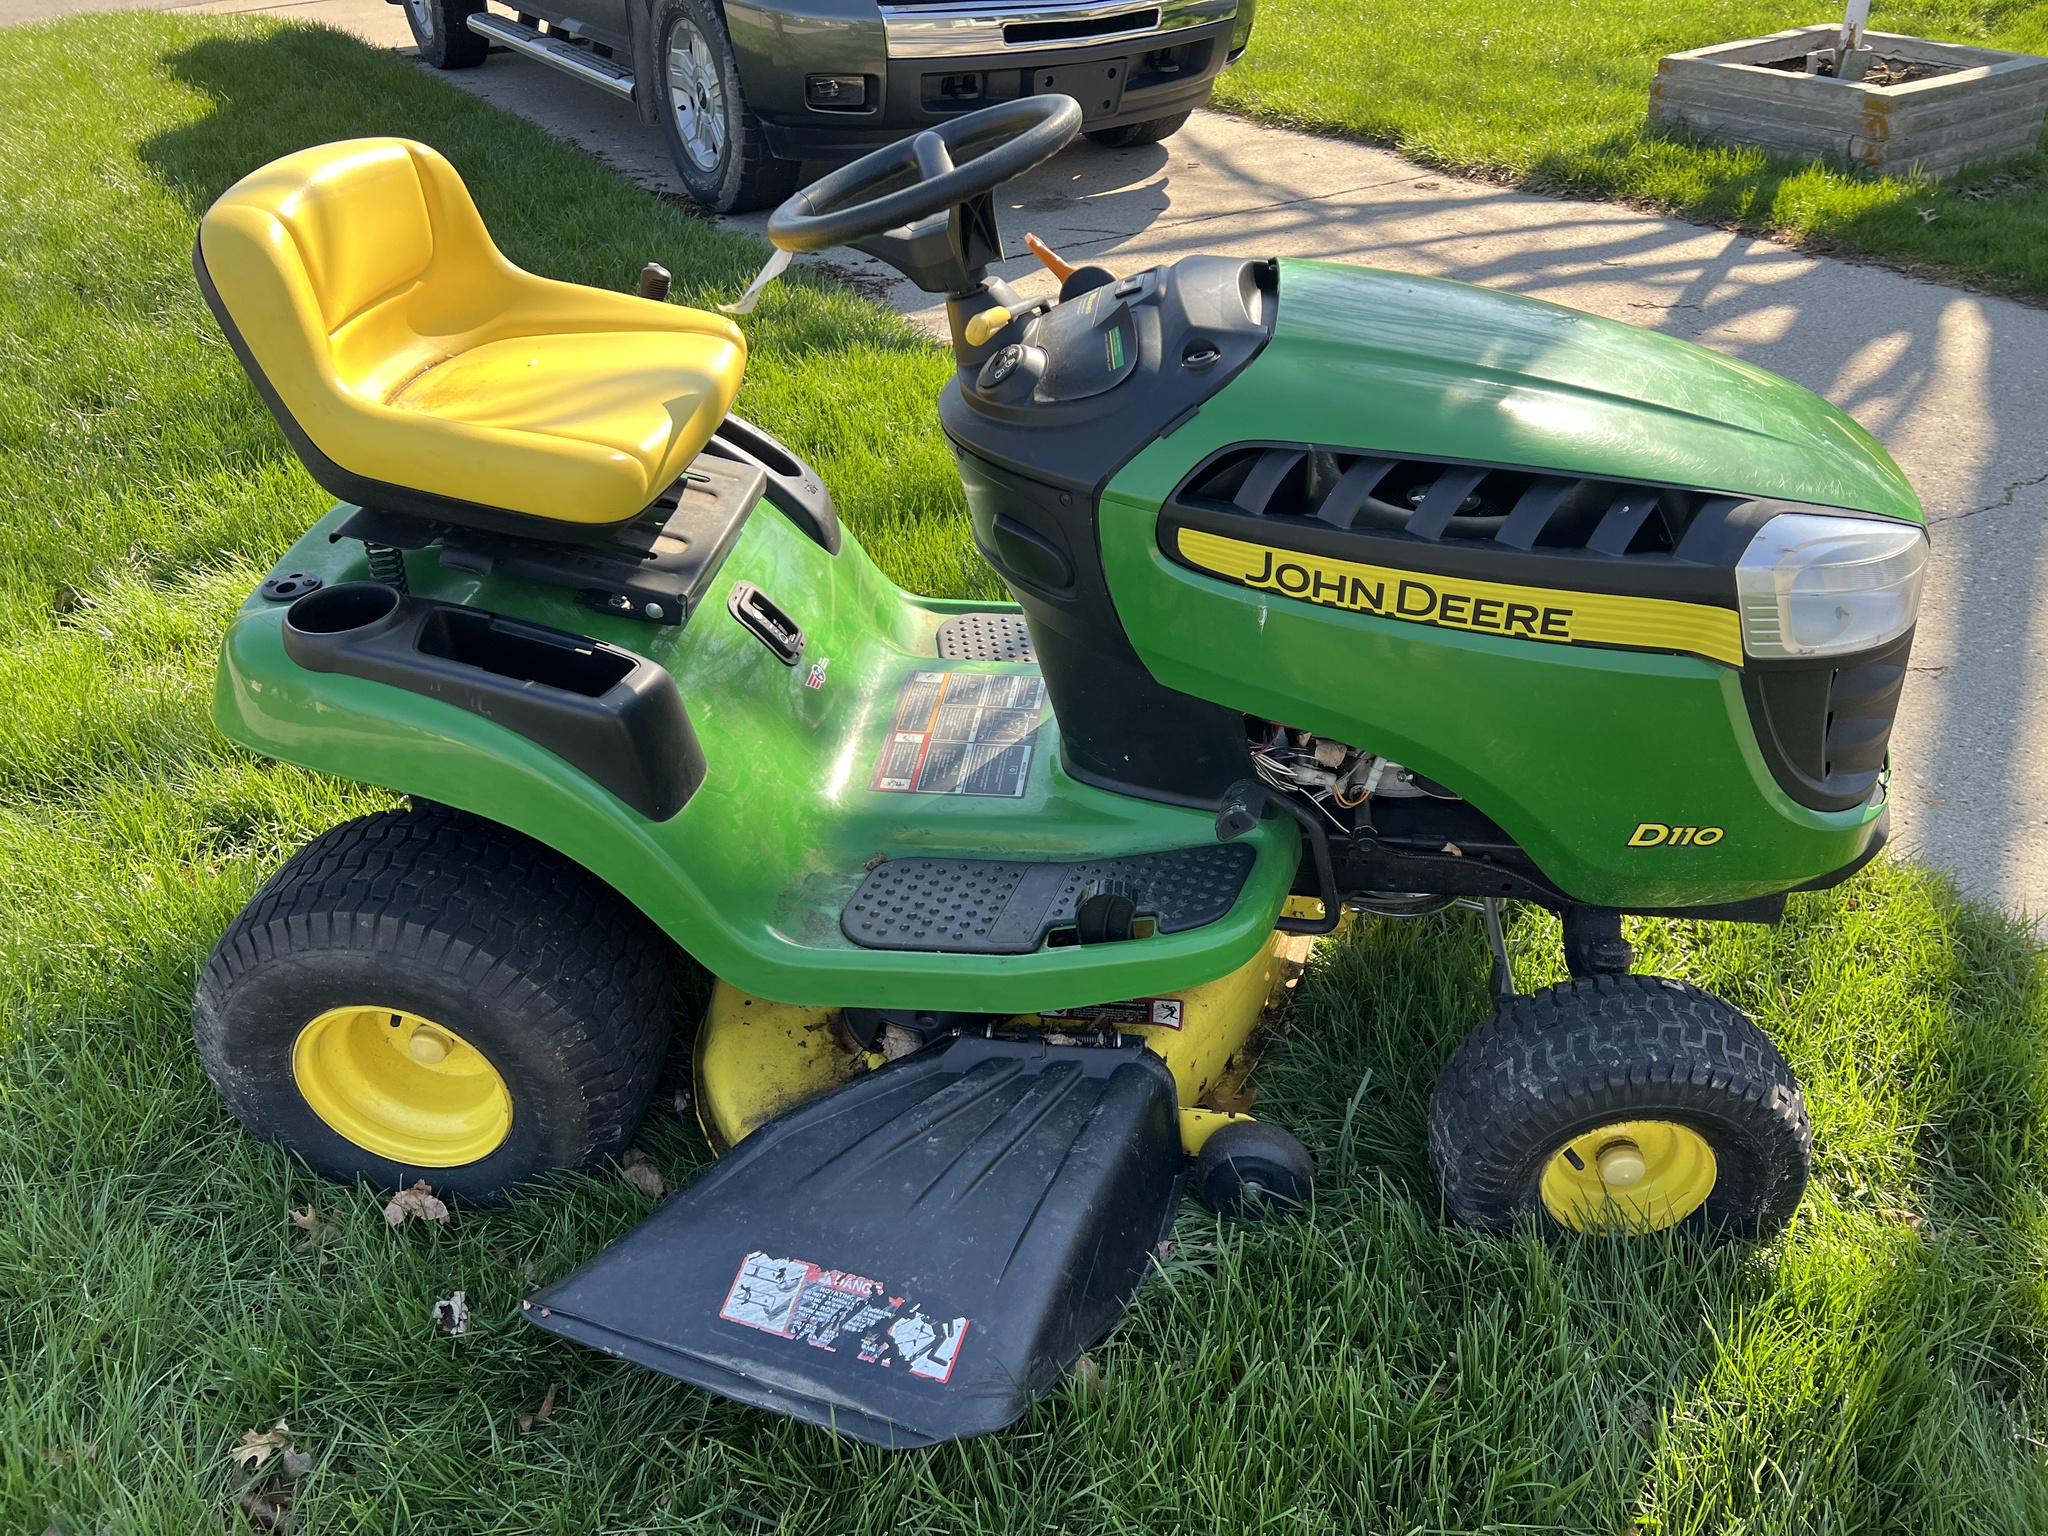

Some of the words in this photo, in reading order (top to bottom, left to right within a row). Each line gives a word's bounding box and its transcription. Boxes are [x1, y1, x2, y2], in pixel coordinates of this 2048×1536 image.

[1245, 552, 1385, 610] JOHN
[1398, 578, 1573, 637] DEERE
[1626, 822, 1725, 847] D110
